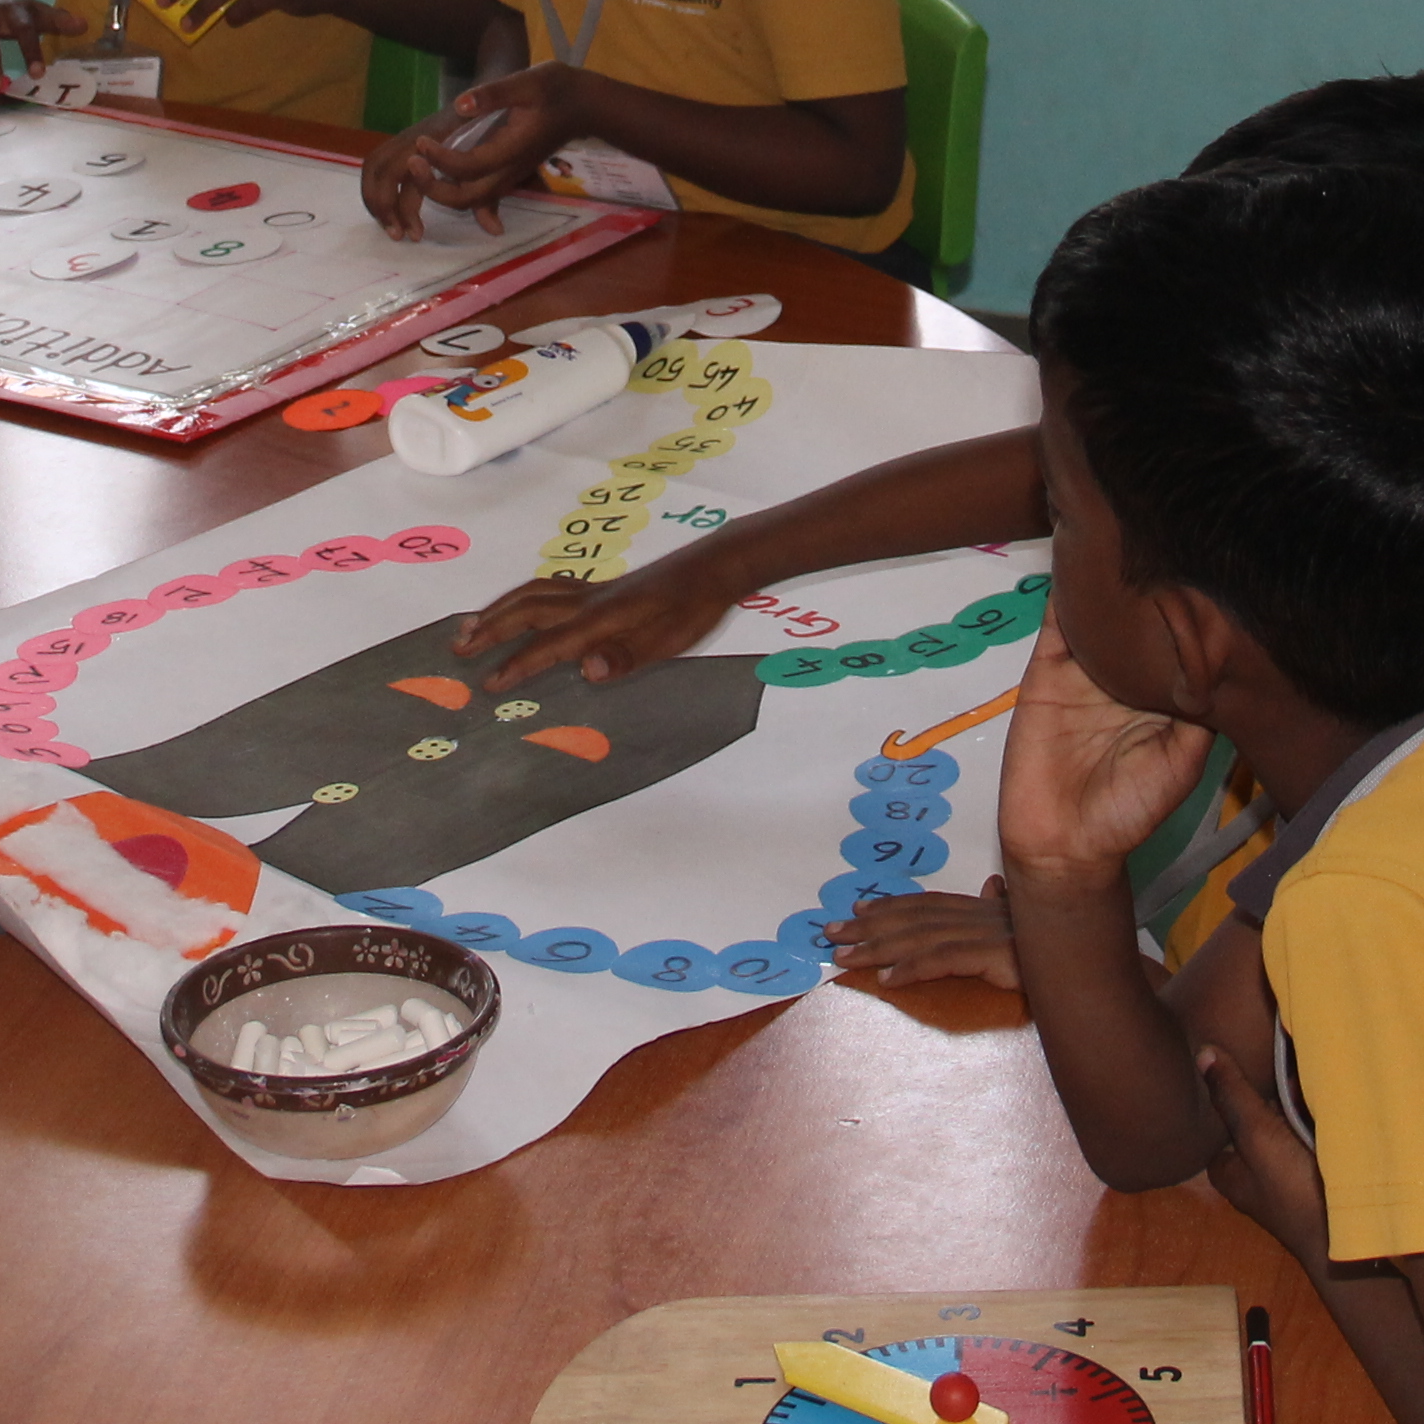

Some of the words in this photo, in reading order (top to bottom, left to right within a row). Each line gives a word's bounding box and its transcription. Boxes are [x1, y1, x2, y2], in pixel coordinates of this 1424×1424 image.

[18, 182, 51, 207] 4
[199, 239, 245, 257] 8
[642, 356, 685, 382] 50
[688, 361, 740, 392] 45
[706, 395, 760, 422] 40
[657, 435, 721, 453] 35
[582, 483, 646, 505] 25
[565, 514, 628, 535] 20
[315, 544, 371, 568] 27
[398, 534, 460, 559] 30
[550, 541, 603, 559] 15
[239, 558, 290, 582] 24
[164, 584, 212, 603] 21
[100, 611, 139, 625] 18
[959, 609, 1018, 636] 16
[36, 639, 86, 656] 15
[908, 632, 958, 658] 12
[781, 657, 823, 678] 4
[840, 652, 886, 670] 8
[9, 665, 51, 685] 12
[885, 801, 929, 822] 18
[873, 841, 925, 866] 16
[531, 940, 593, 964] 6
[651, 955, 693, 982] 8
[729, 957, 791, 985] 10
[937, 1303, 982, 1322] 3
[822, 1327, 864, 1344] 2
[1053, 1317, 1095, 1338] 4
[734, 1378, 776, 1387] 1
[1139, 1365, 1183, 1382] 5
